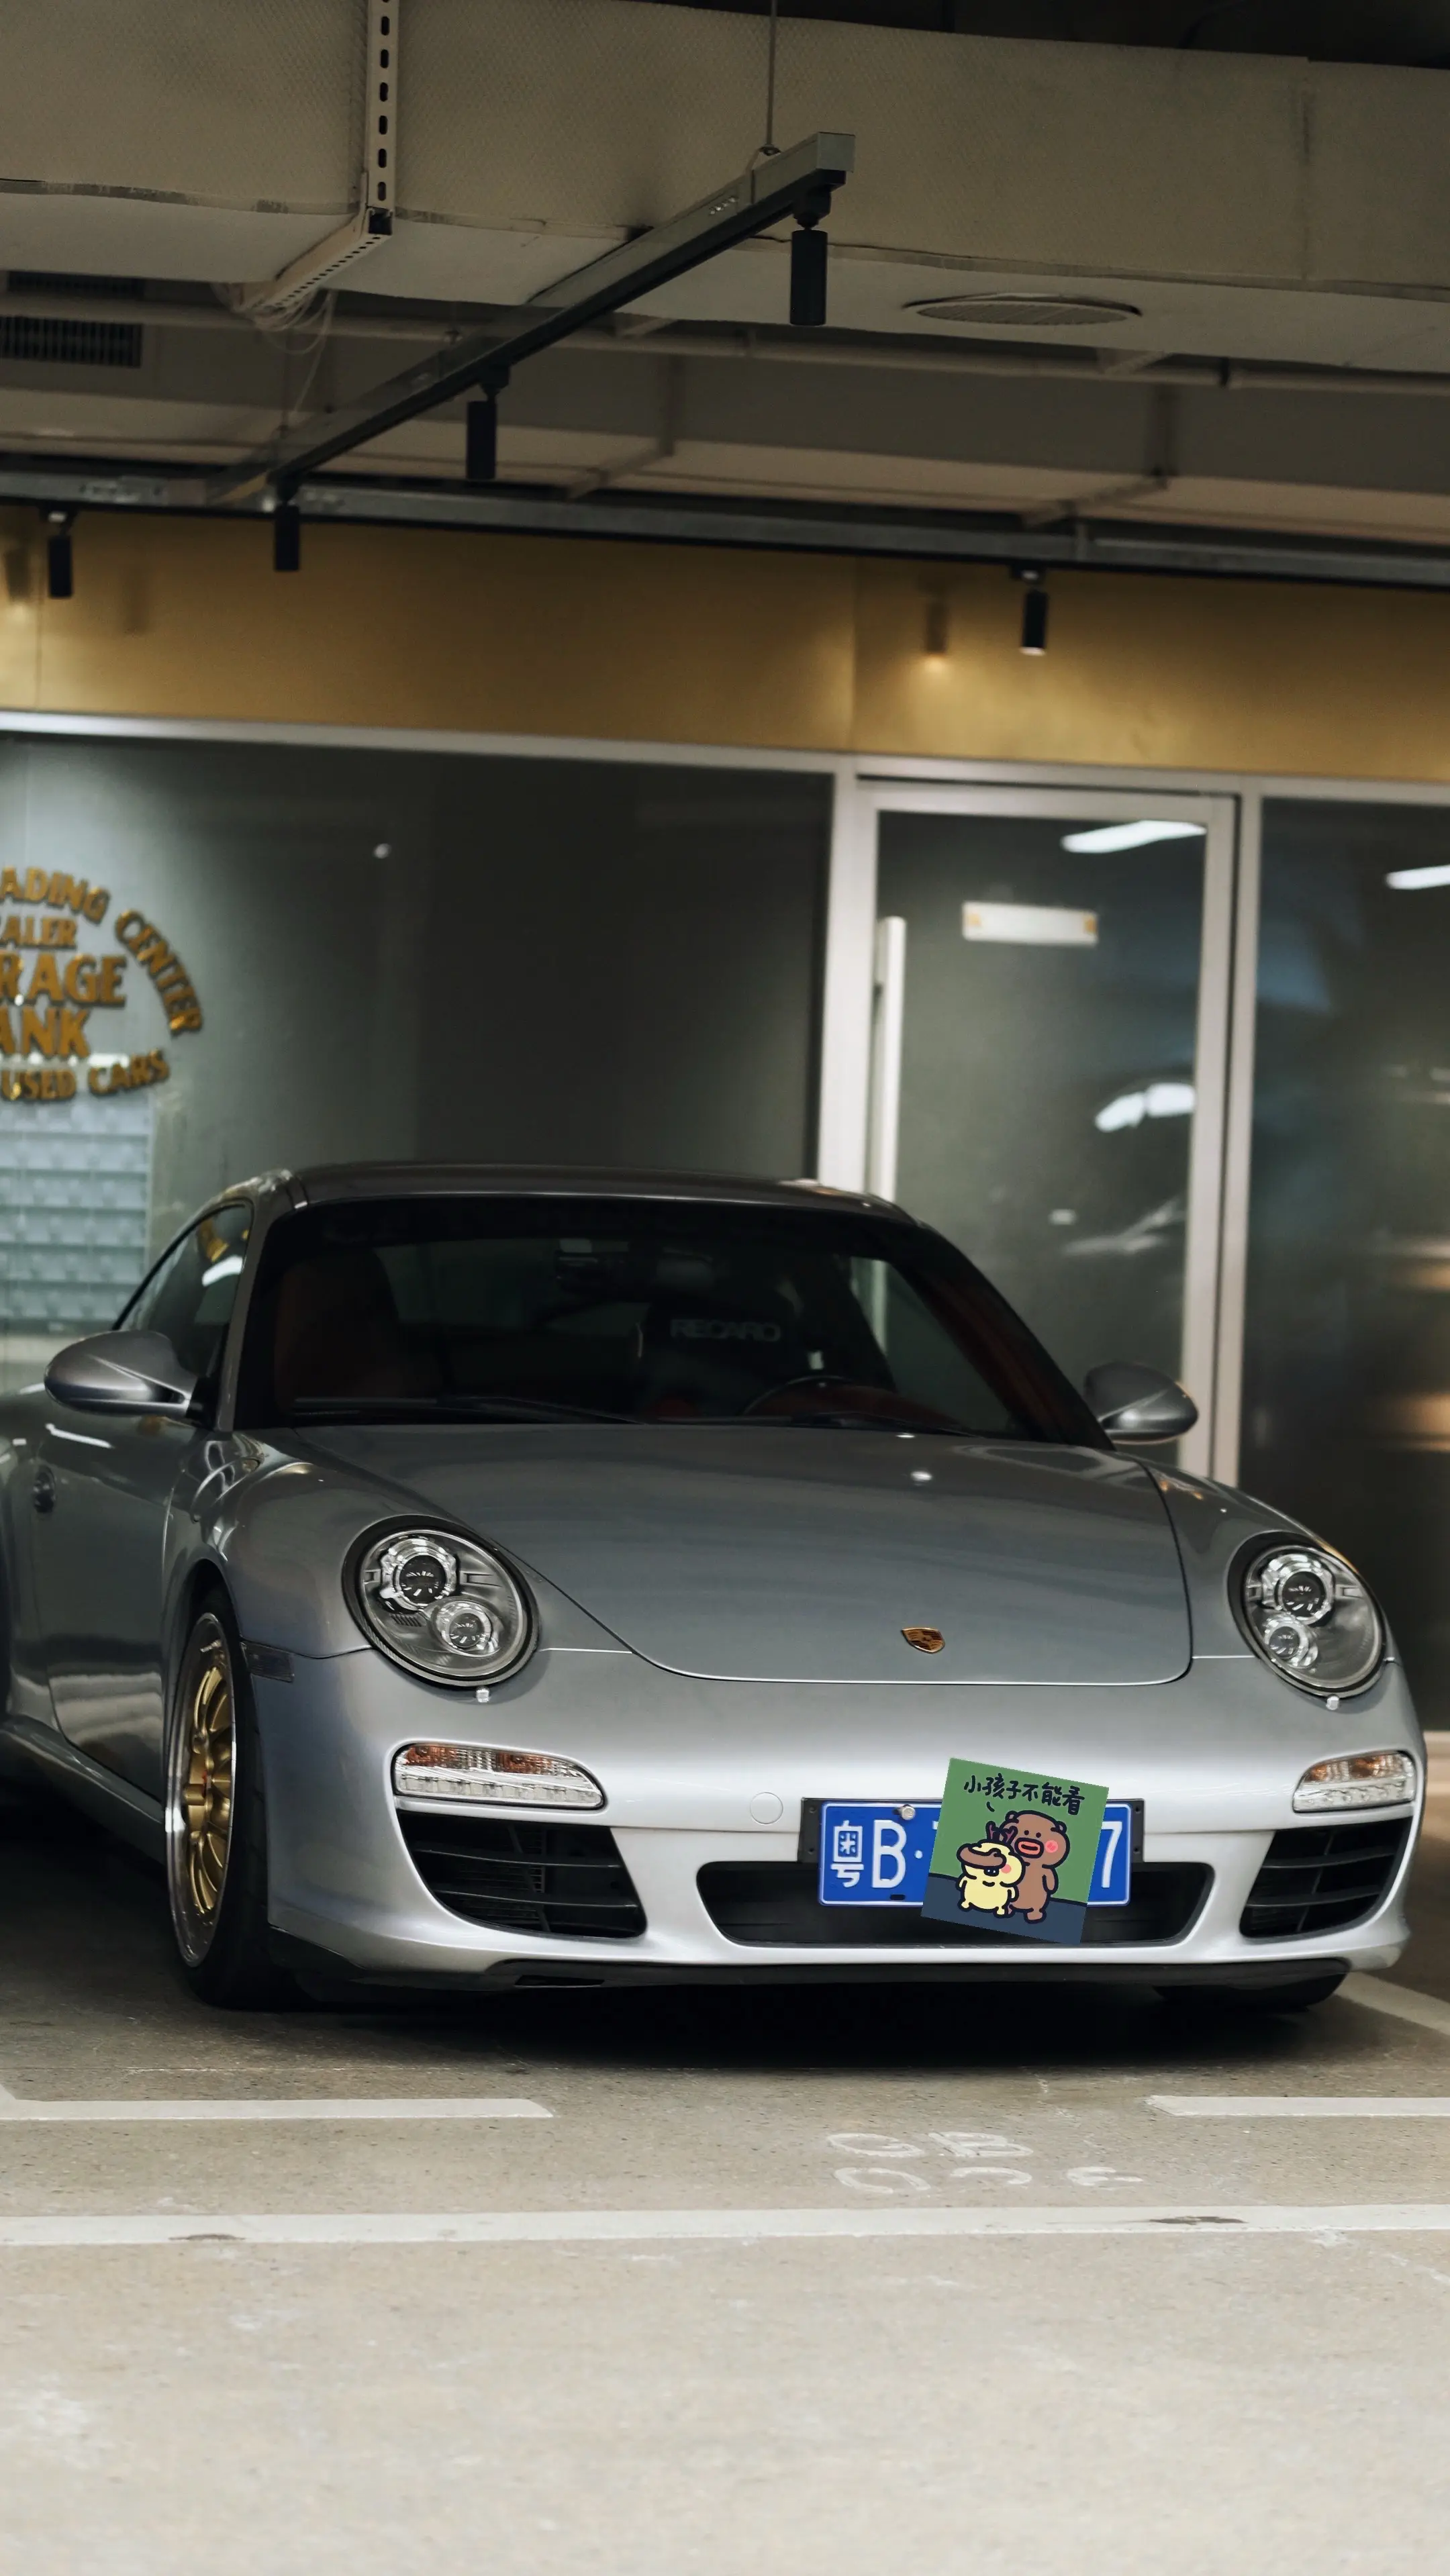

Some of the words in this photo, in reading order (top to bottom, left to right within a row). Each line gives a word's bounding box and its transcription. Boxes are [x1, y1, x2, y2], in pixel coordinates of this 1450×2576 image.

[115, 909, 203, 1034] CENTER
[2, 1069, 76, 1099] USED
[88, 1050, 170, 1094] CARS
[826, 2132, 1034, 2158] GB
